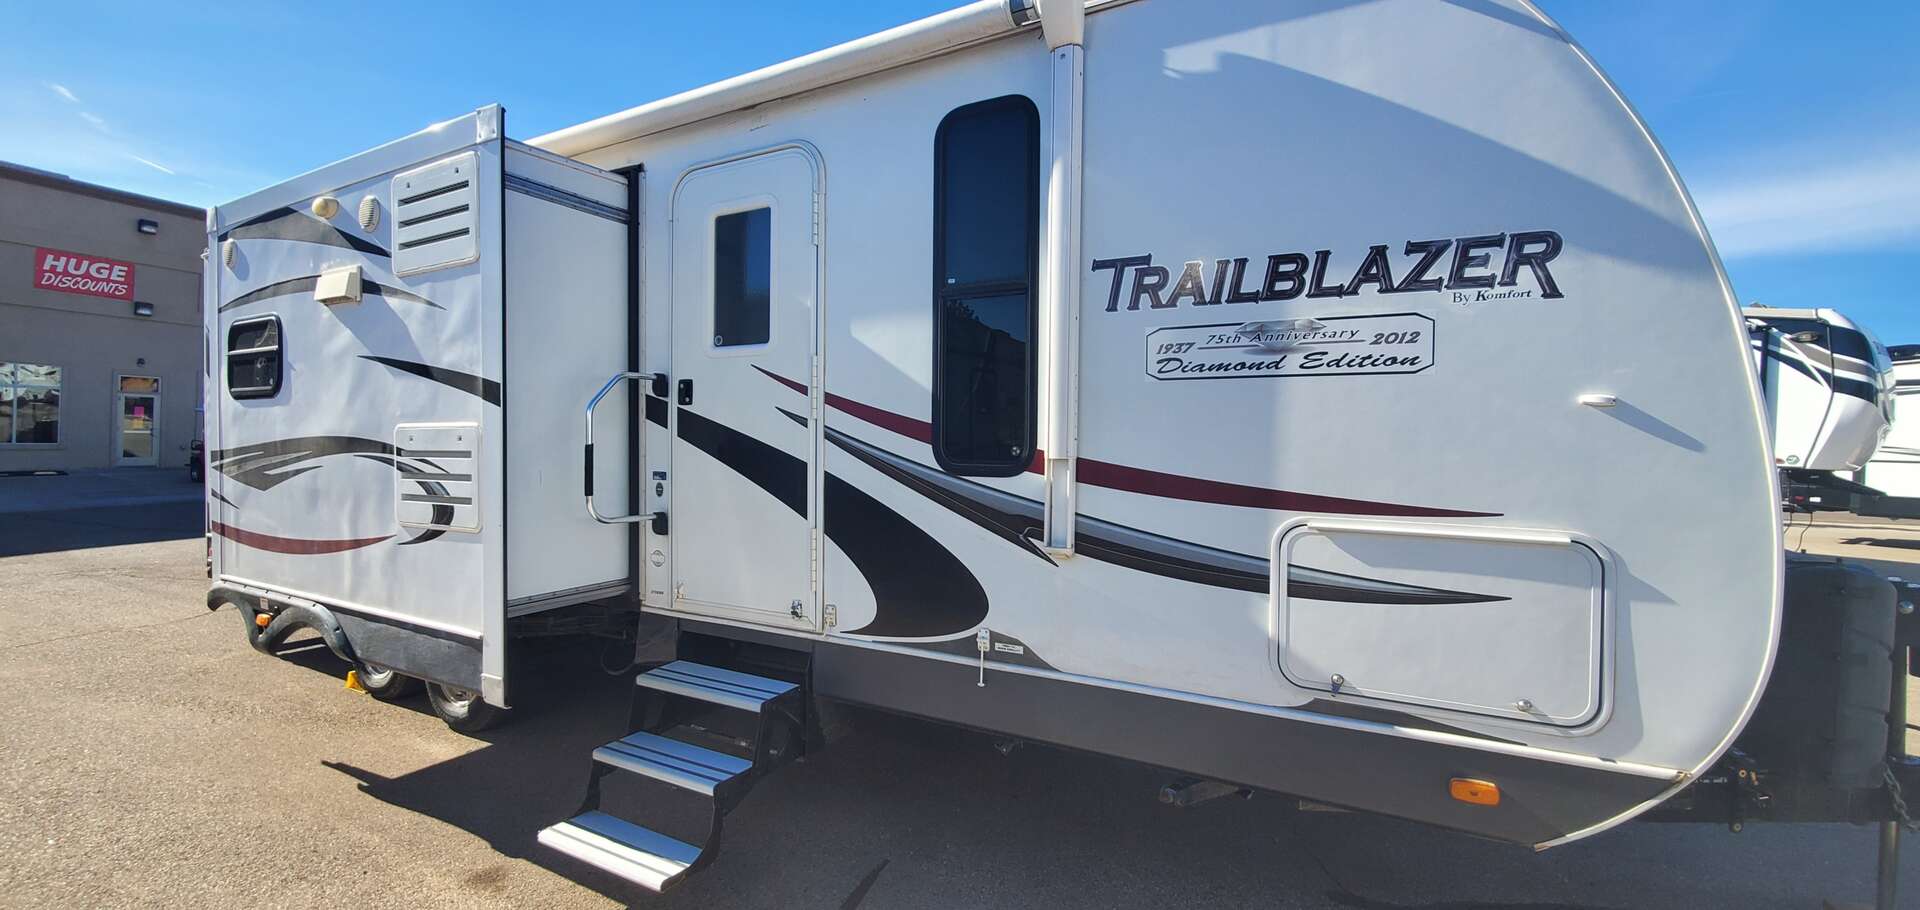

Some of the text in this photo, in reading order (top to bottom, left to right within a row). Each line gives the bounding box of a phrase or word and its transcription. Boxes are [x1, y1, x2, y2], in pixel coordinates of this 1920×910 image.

[42, 254, 128, 281] HUGE
[1091, 230, 1564, 312] TRAILBLAZER
[41, 272, 128, 295] DISCOUNTS
[1453, 289, 1532, 306] By Komfort
[1156, 329, 1421, 355] 1937 75th Anniversary 2012
[1156, 351, 1422, 374] Diamond Edition
